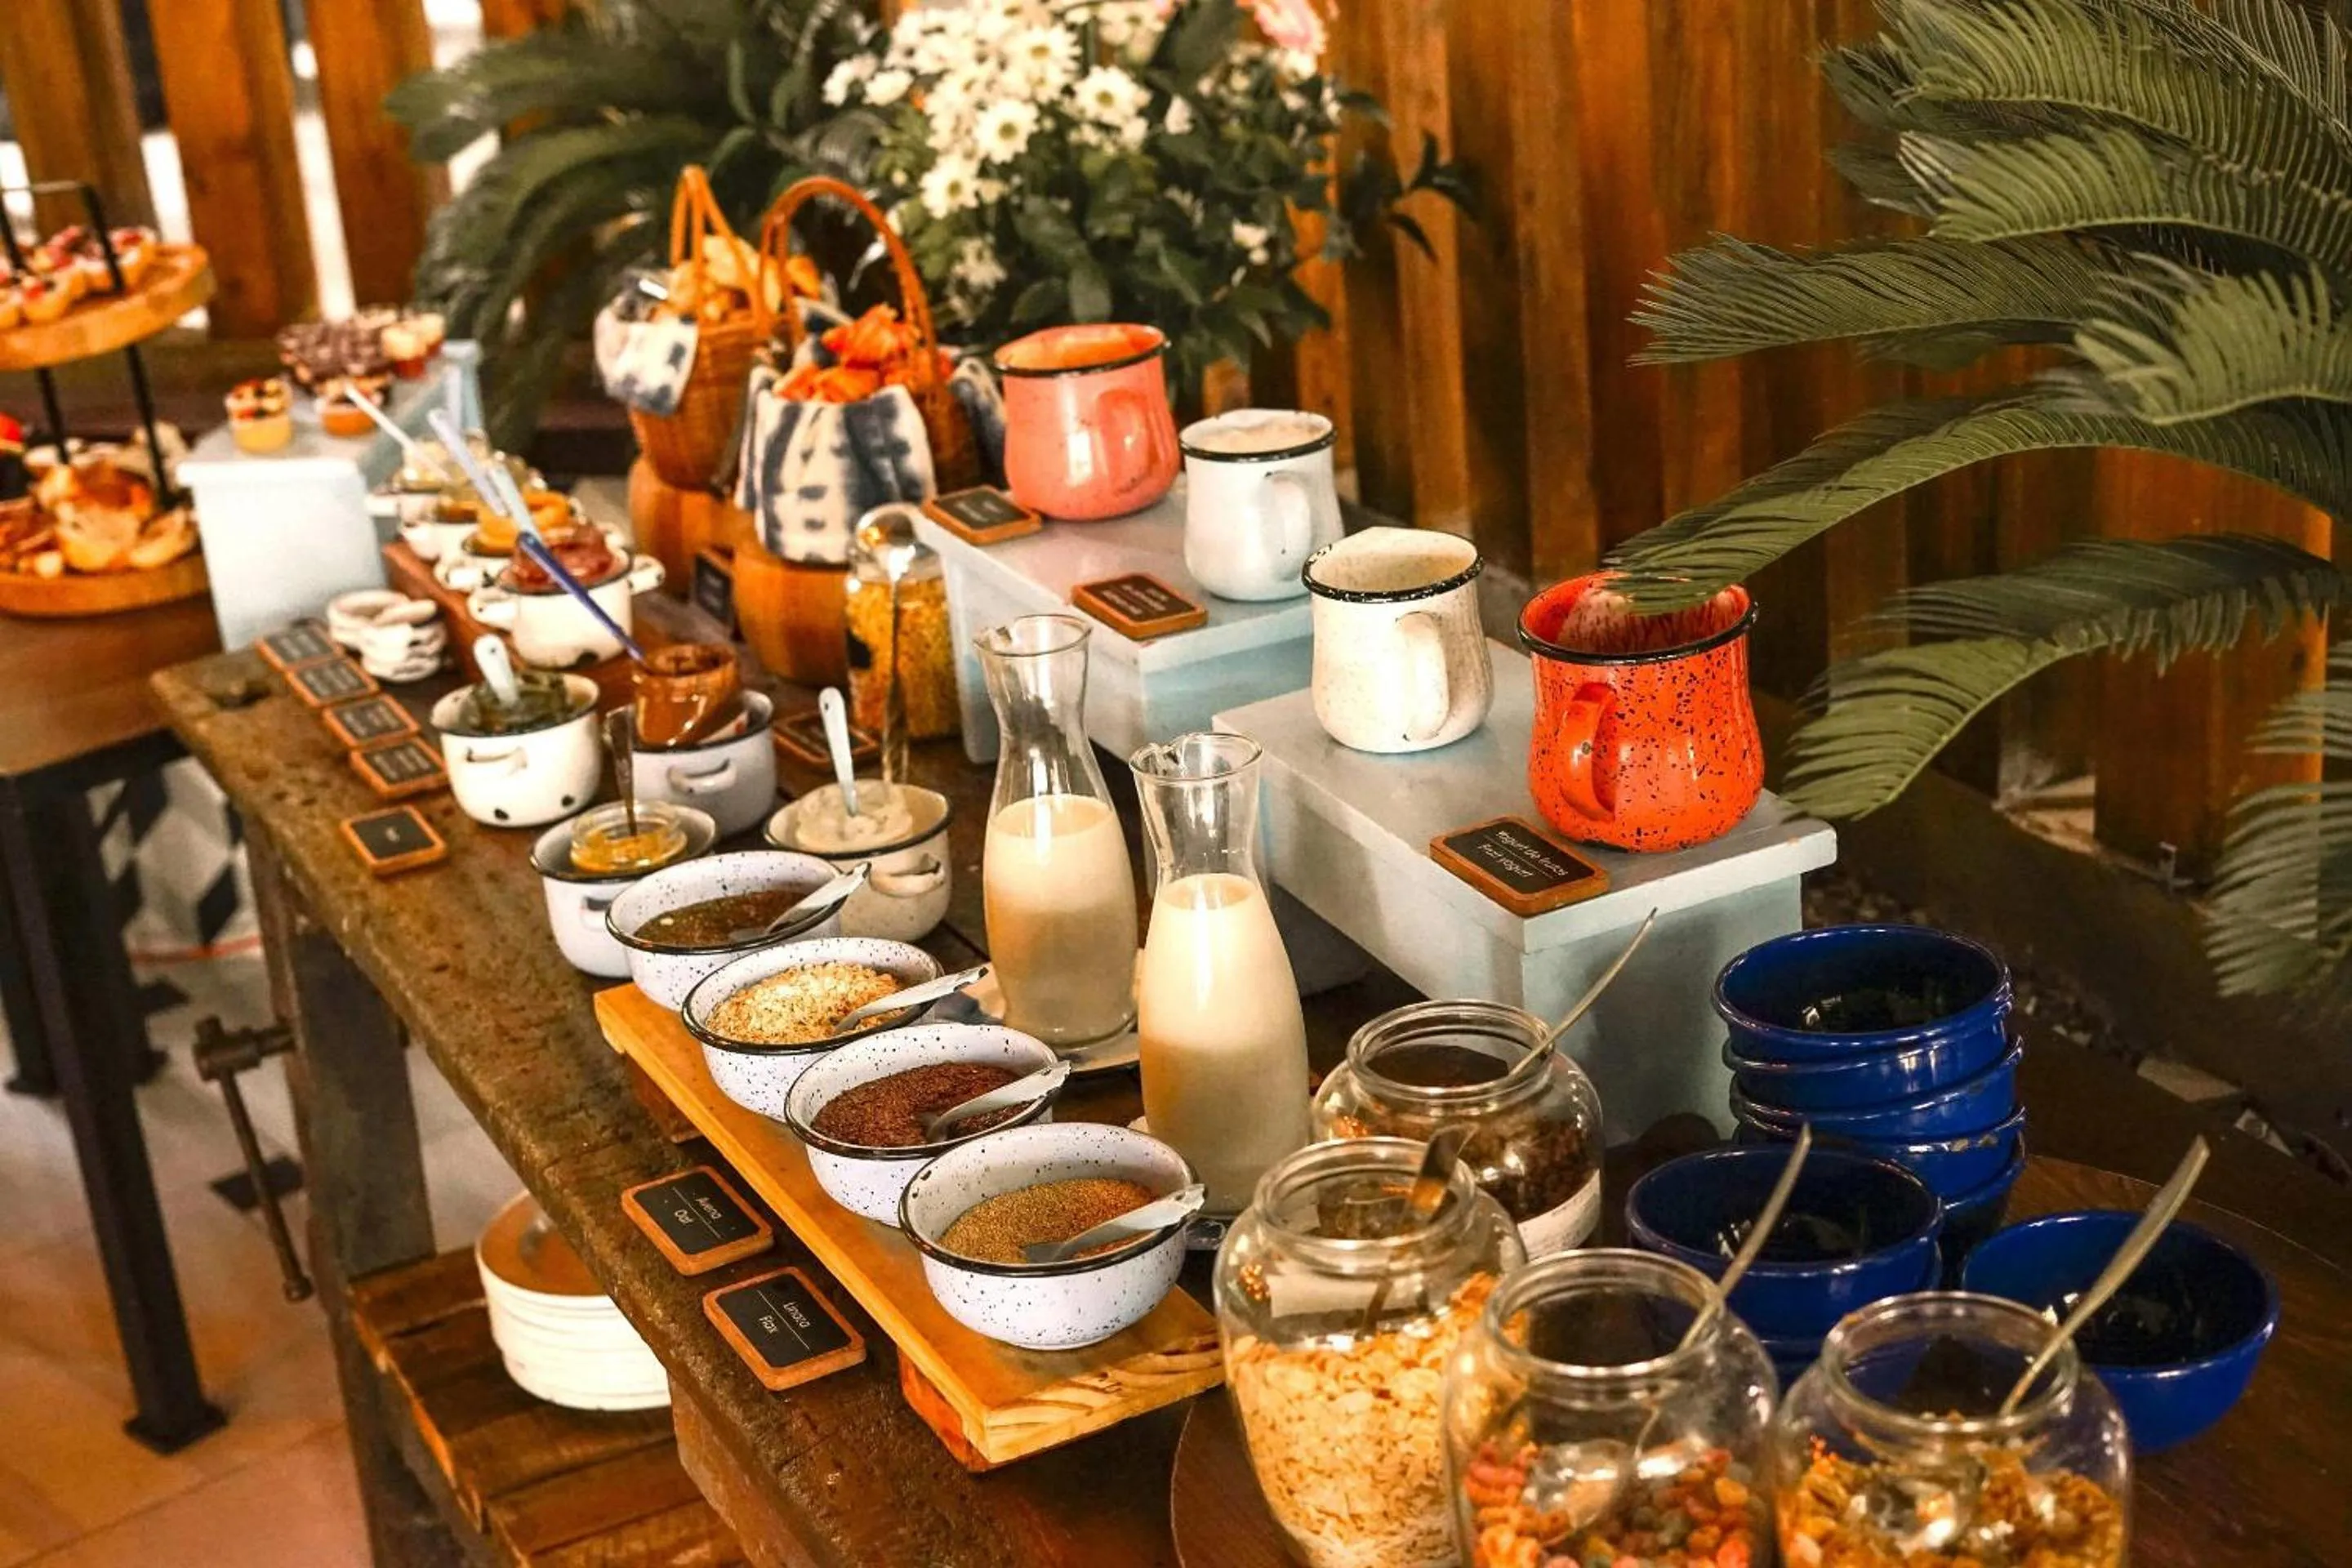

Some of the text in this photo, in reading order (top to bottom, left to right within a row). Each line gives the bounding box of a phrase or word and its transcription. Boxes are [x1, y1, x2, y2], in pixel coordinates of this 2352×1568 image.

[1524, 849, 1540, 859] de
[674, 1209, 694, 1225] Oat
[695, 1197, 722, 1219] Avena
[759, 1314, 777, 1334] Flax
[783, 1301, 811, 1329] Linaza
